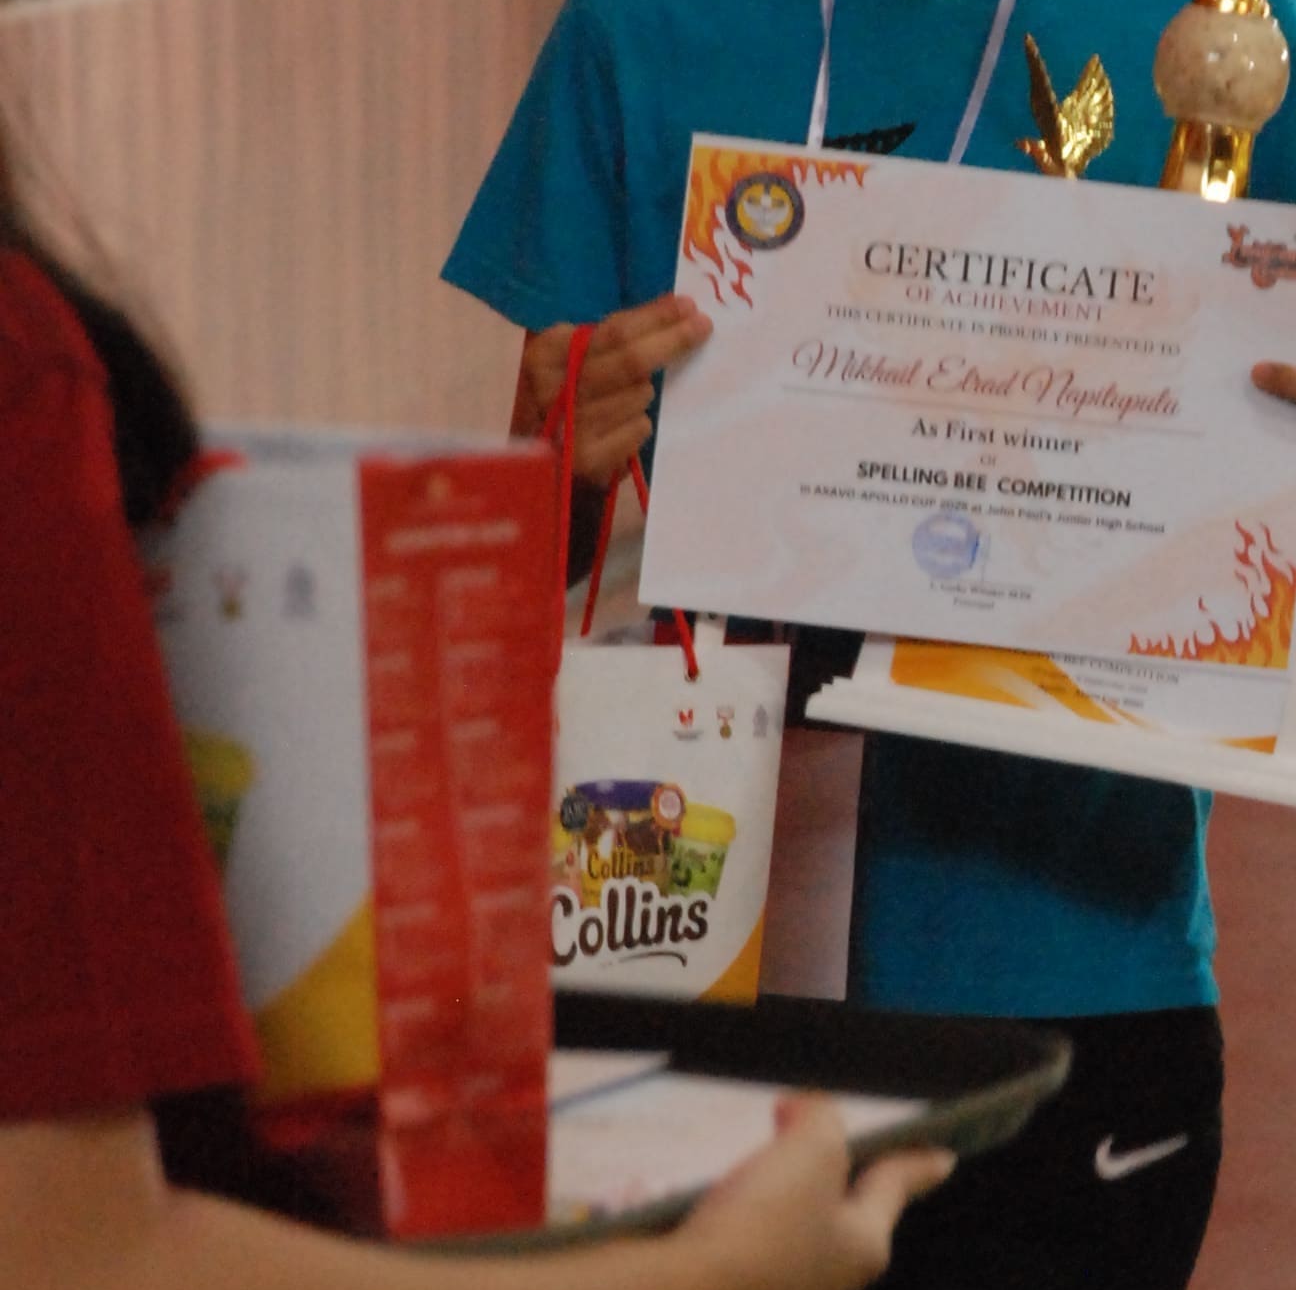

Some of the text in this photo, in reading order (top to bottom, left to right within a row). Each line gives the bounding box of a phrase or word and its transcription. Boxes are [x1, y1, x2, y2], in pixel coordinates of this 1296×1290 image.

[863, 240, 1155, 306] CERTIFICATE
[904, 282, 1104, 322] OF ACHIEVEMENT
[865, 310, 964, 333] CERTIFICATE
[989, 323, 1060, 344] PROUDLY
[1064, 330, 1155, 354] PRESENTED
[1159, 340, 1182, 356] TO
[911, 417, 1084, 455] As First winner
[857, 461, 1132, 508] SPELLING BEE COMPETITION
[552, 885, 709, 967] Collins
